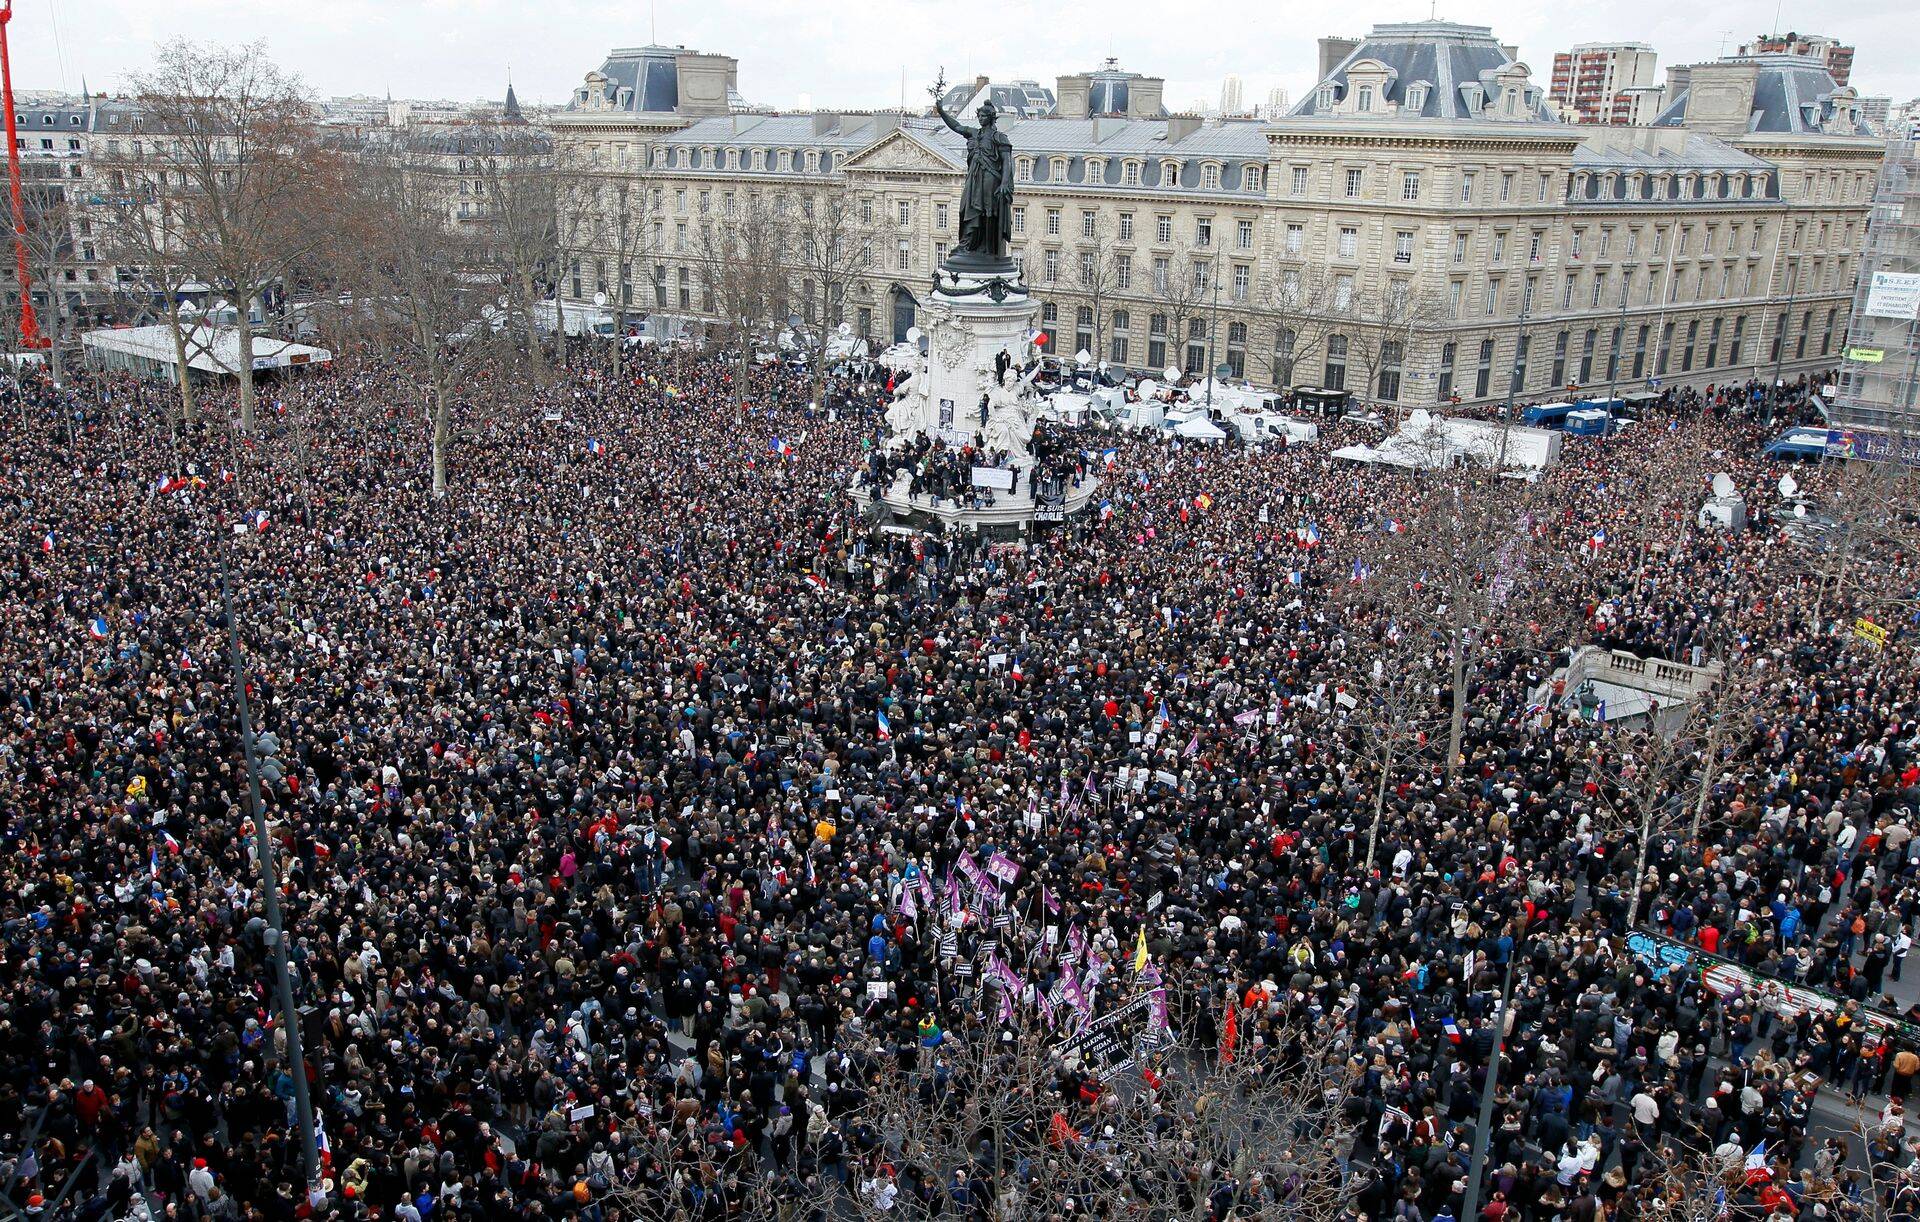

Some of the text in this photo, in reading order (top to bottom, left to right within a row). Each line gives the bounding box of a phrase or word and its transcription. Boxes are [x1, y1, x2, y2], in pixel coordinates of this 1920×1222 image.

[1035, 504, 1064, 512] JE SUIS
[1034, 511, 1064, 521] CHARLIE
